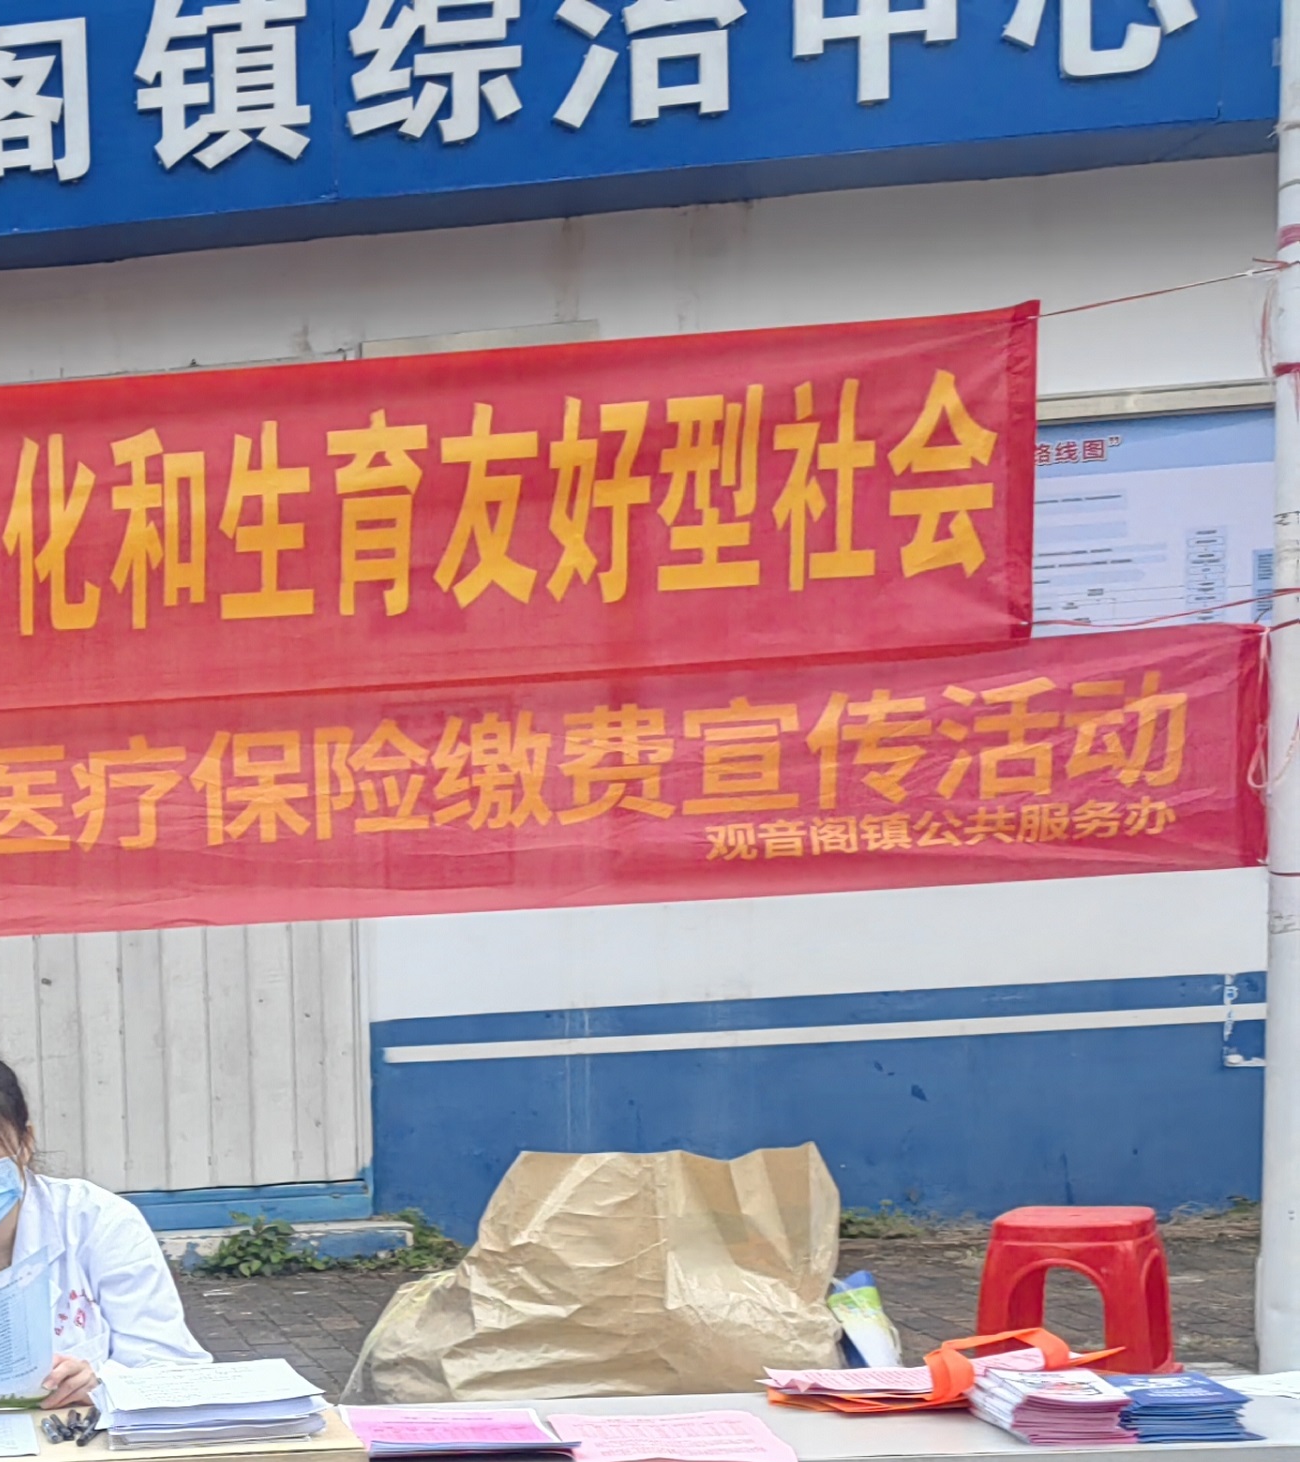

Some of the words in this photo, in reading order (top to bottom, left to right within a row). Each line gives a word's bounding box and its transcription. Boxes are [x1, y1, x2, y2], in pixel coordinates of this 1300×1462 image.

[705, 795, 1176, 861] 观音阁镇公共服务办
